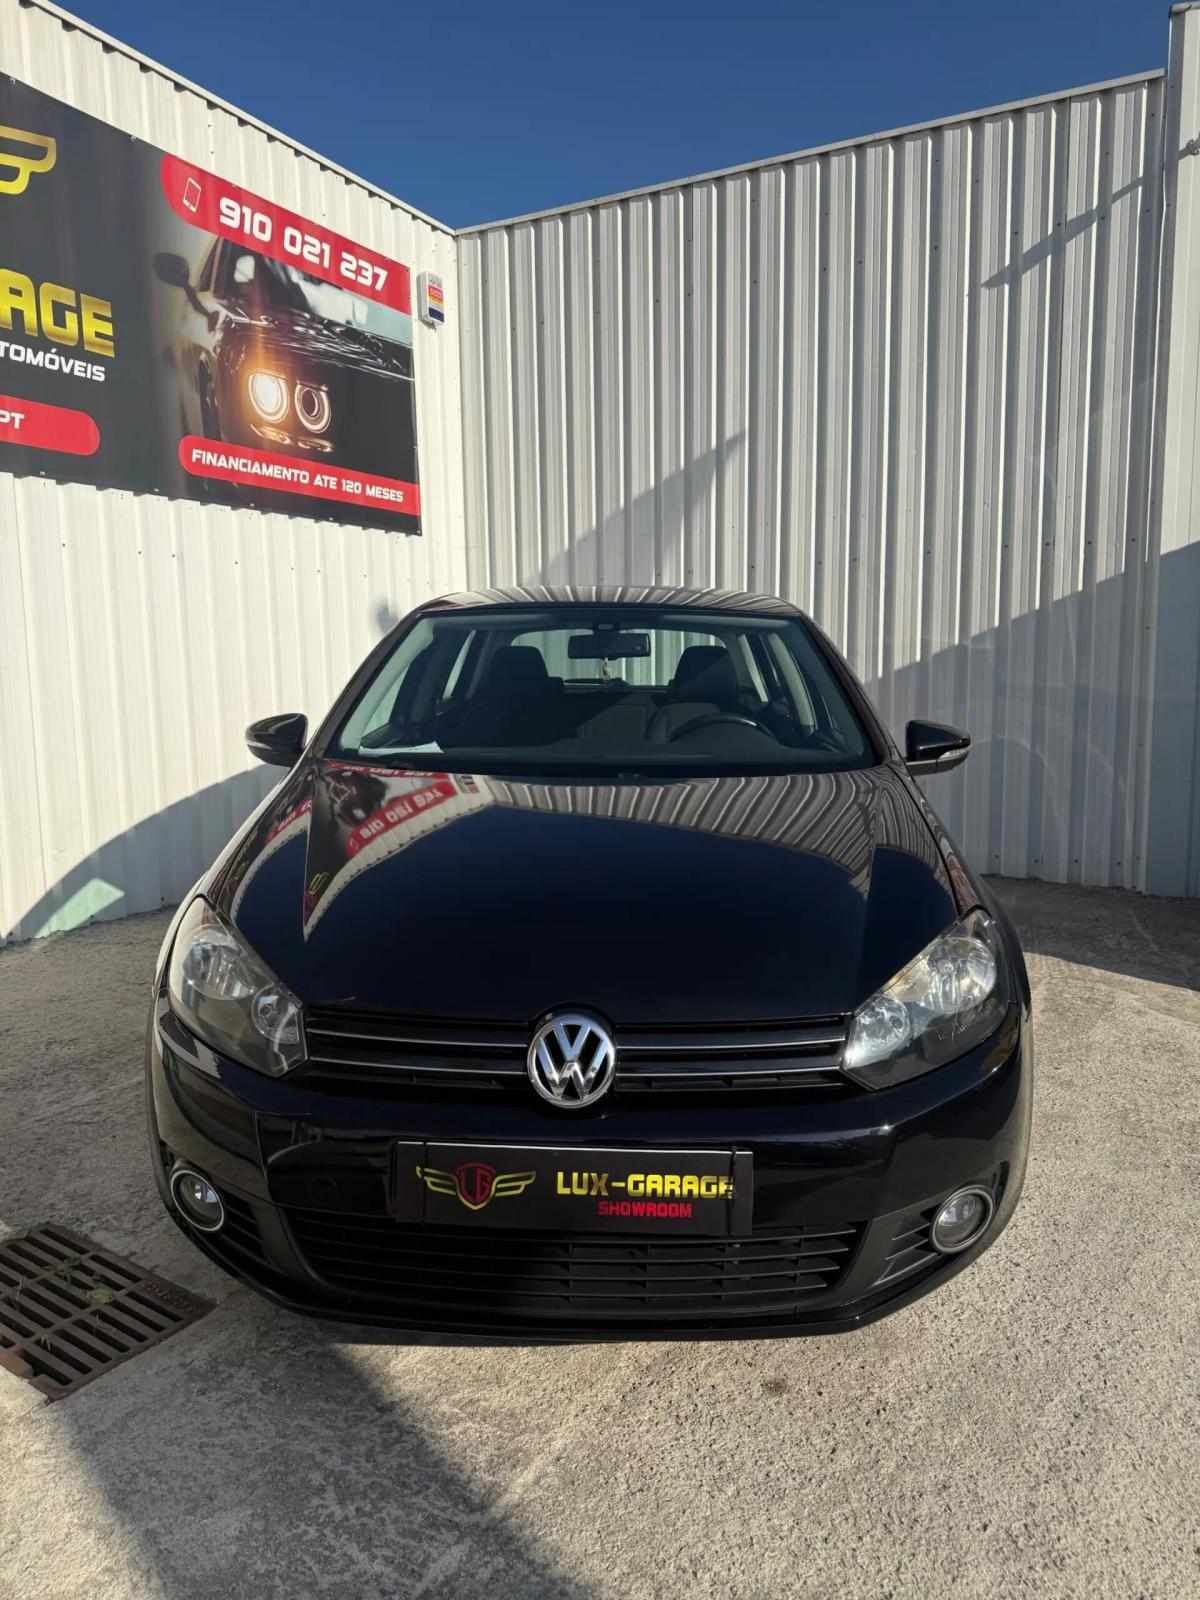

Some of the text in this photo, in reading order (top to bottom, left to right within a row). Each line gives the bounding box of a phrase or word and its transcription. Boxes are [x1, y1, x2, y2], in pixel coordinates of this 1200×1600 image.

[219, 196, 388, 291] 910 021 237
[191, 448, 404, 503] FINANCIAMENTO ATE 120 MESES
[556, 1171, 734, 1200] LUX-GARAGE
[597, 1201, 693, 1218] SHOWROOM
